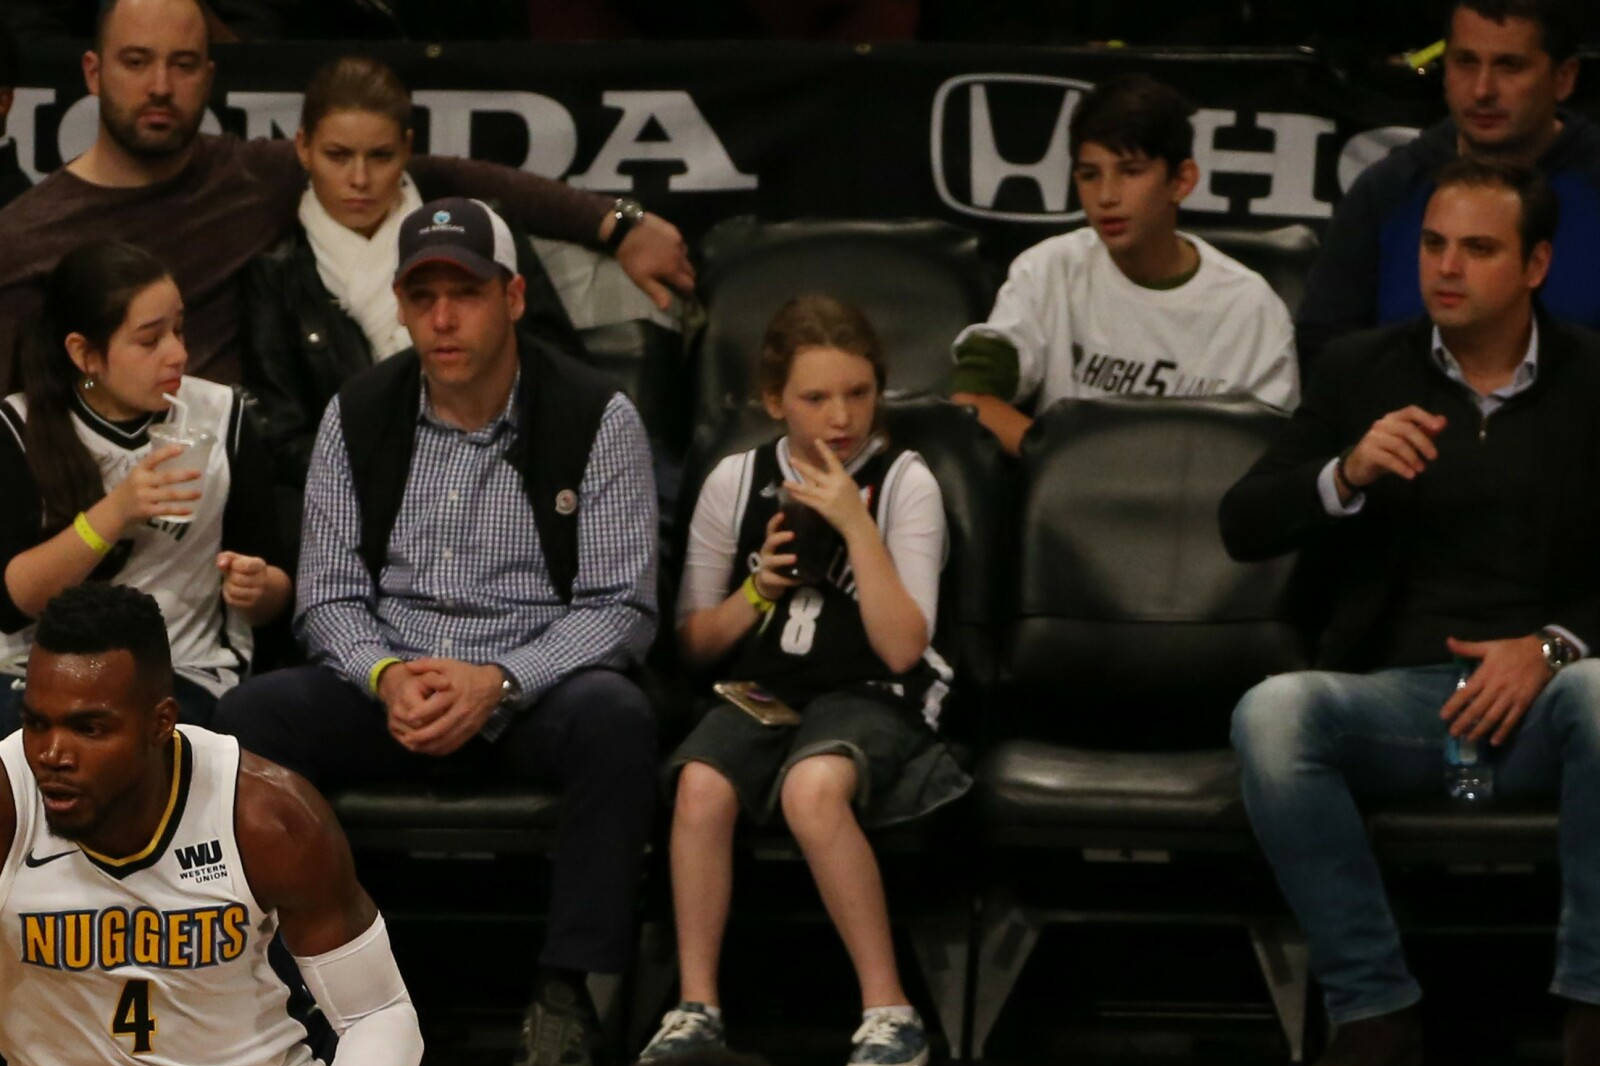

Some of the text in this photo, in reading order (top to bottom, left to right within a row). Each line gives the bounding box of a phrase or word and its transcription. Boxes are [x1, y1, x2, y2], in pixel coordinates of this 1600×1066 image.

[1145, 358, 1178, 397] 5
[780, 586, 825, 656] 8
[174, 839, 223, 870] WU
[180, 863, 226, 879] WESTERN
[195, 871, 228, 884] UNION
[18, 902, 250, 971] NUGGETS
[112, 978, 158, 1055] 4
